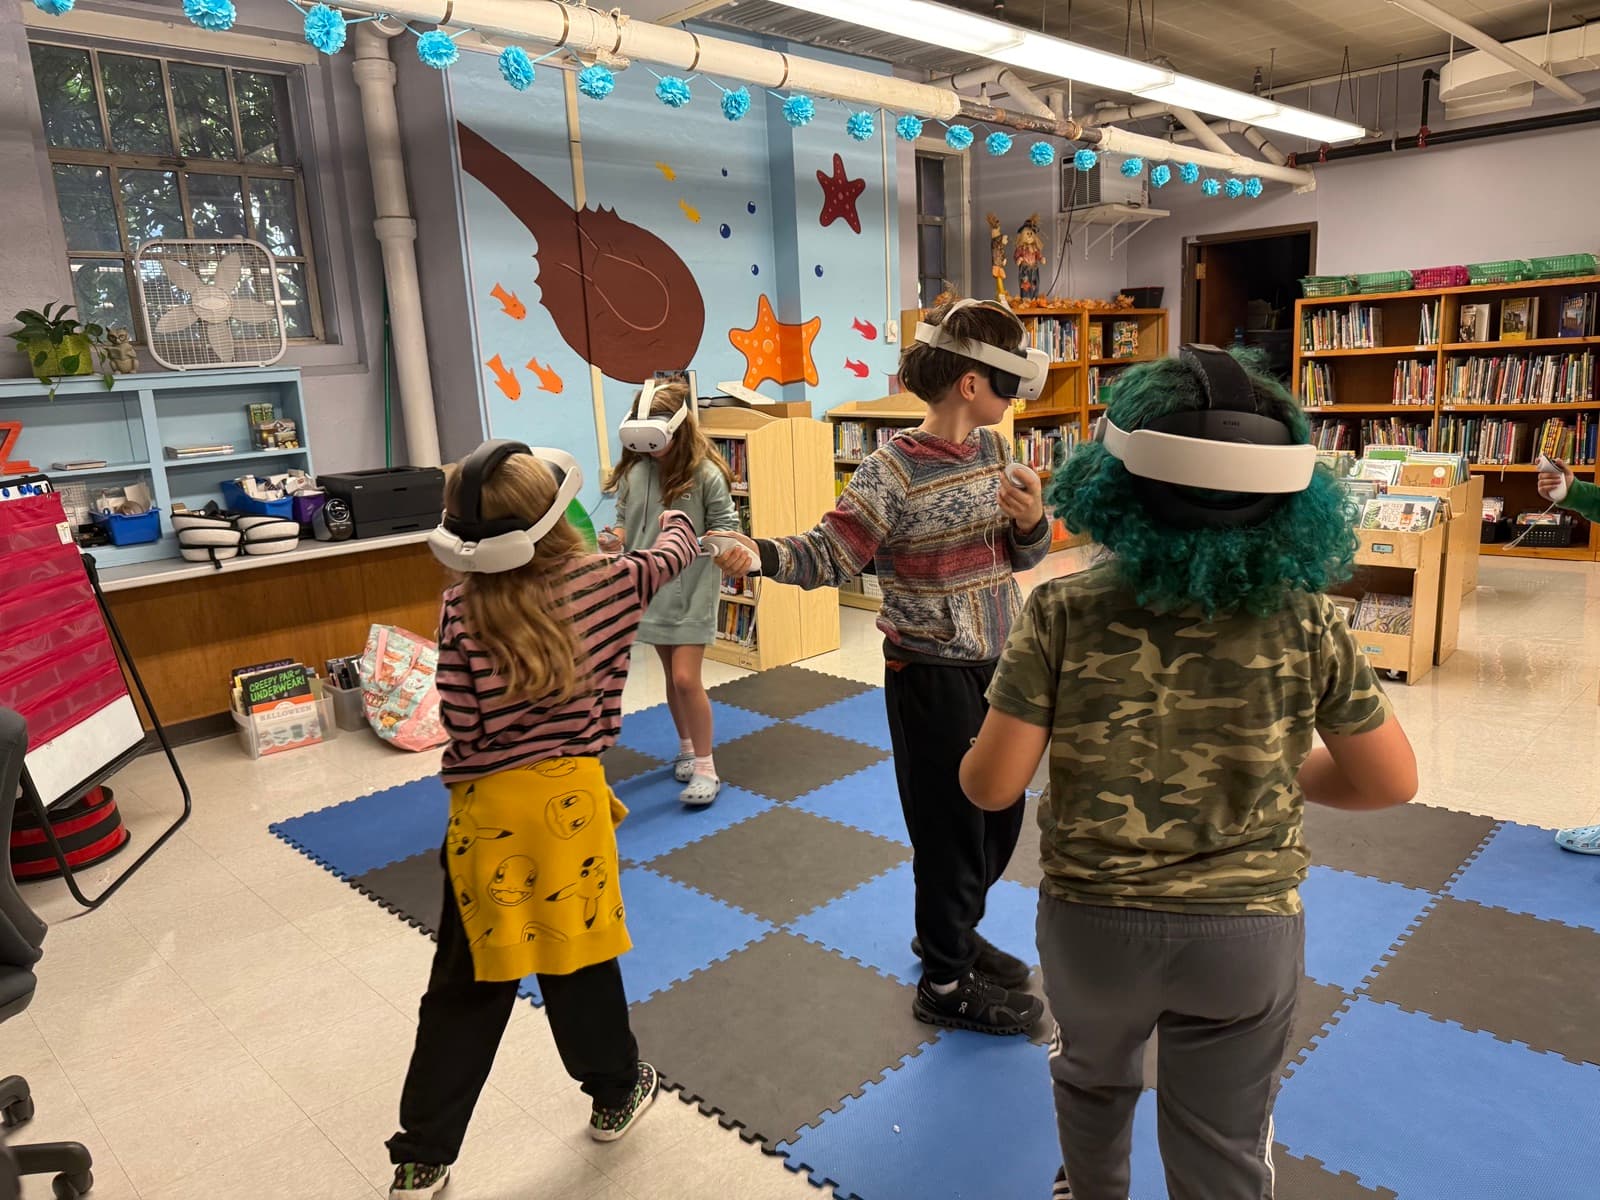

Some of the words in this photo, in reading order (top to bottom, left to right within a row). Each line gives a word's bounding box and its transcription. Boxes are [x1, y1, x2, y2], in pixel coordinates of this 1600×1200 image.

[249, 676, 278, 692] CREEPY
[279, 670, 295, 682] PAIR
[250, 675, 306, 703] UNDERWEAR!
[260, 704, 312, 721] HALLOWEEN
